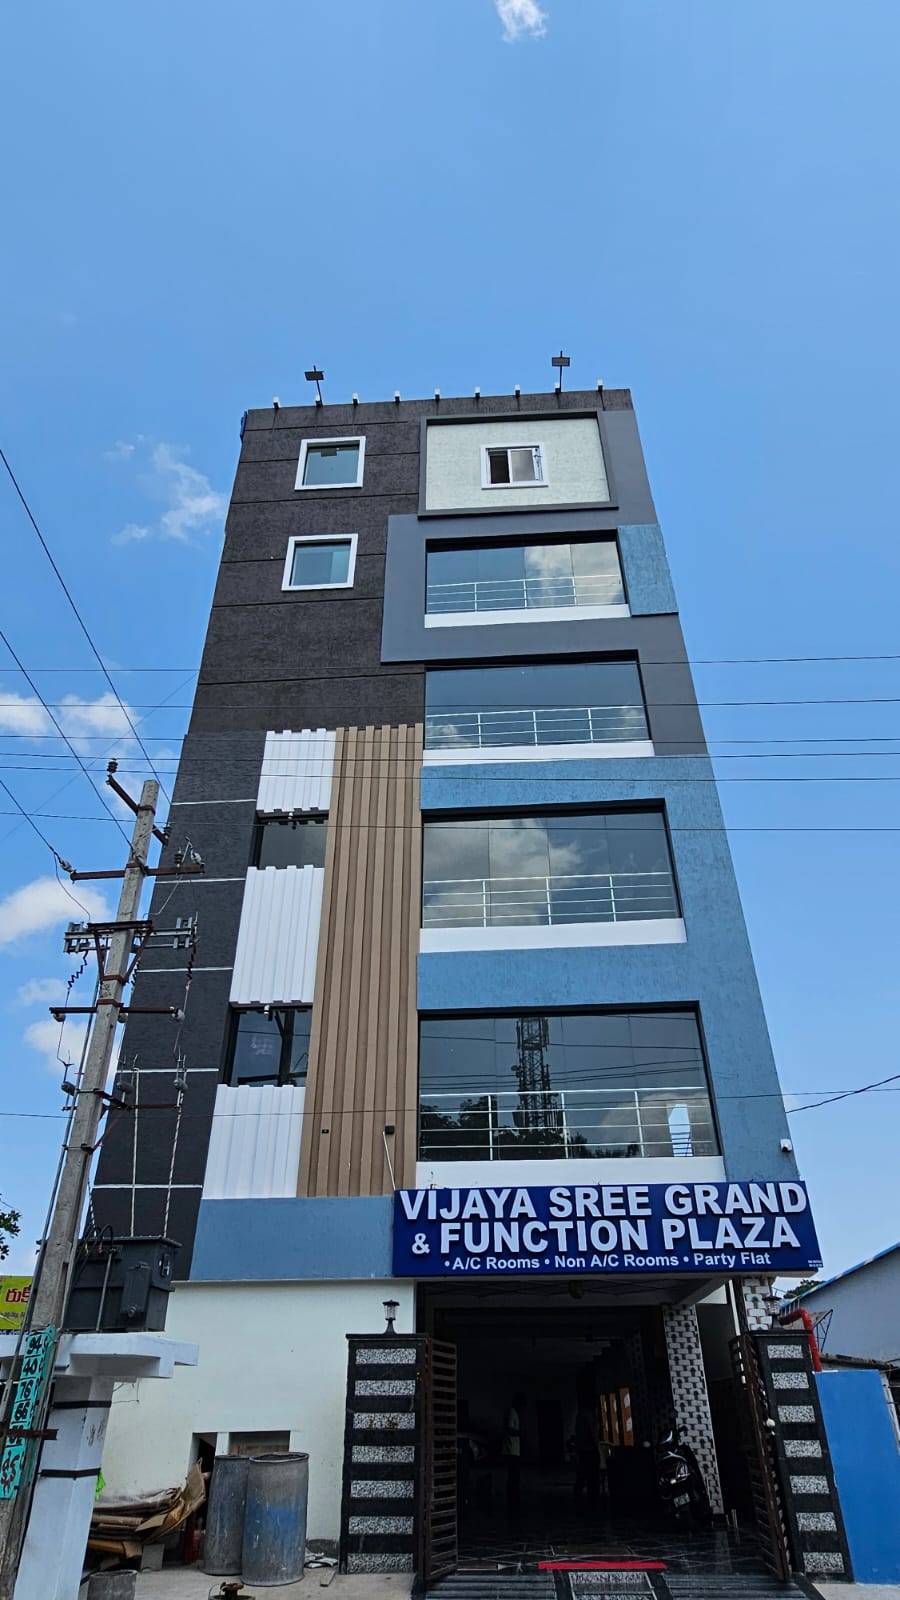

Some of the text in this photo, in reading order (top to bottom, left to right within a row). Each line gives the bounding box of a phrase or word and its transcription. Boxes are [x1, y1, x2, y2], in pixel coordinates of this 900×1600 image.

[400, 1182, 807, 1220] VIJAYA SREE GRAND
[411, 1216, 801, 1254] & FUNCTION PLAZA
[452, 1251, 771, 1270] A/C Rooms Non A/C Rooms Party Flat
